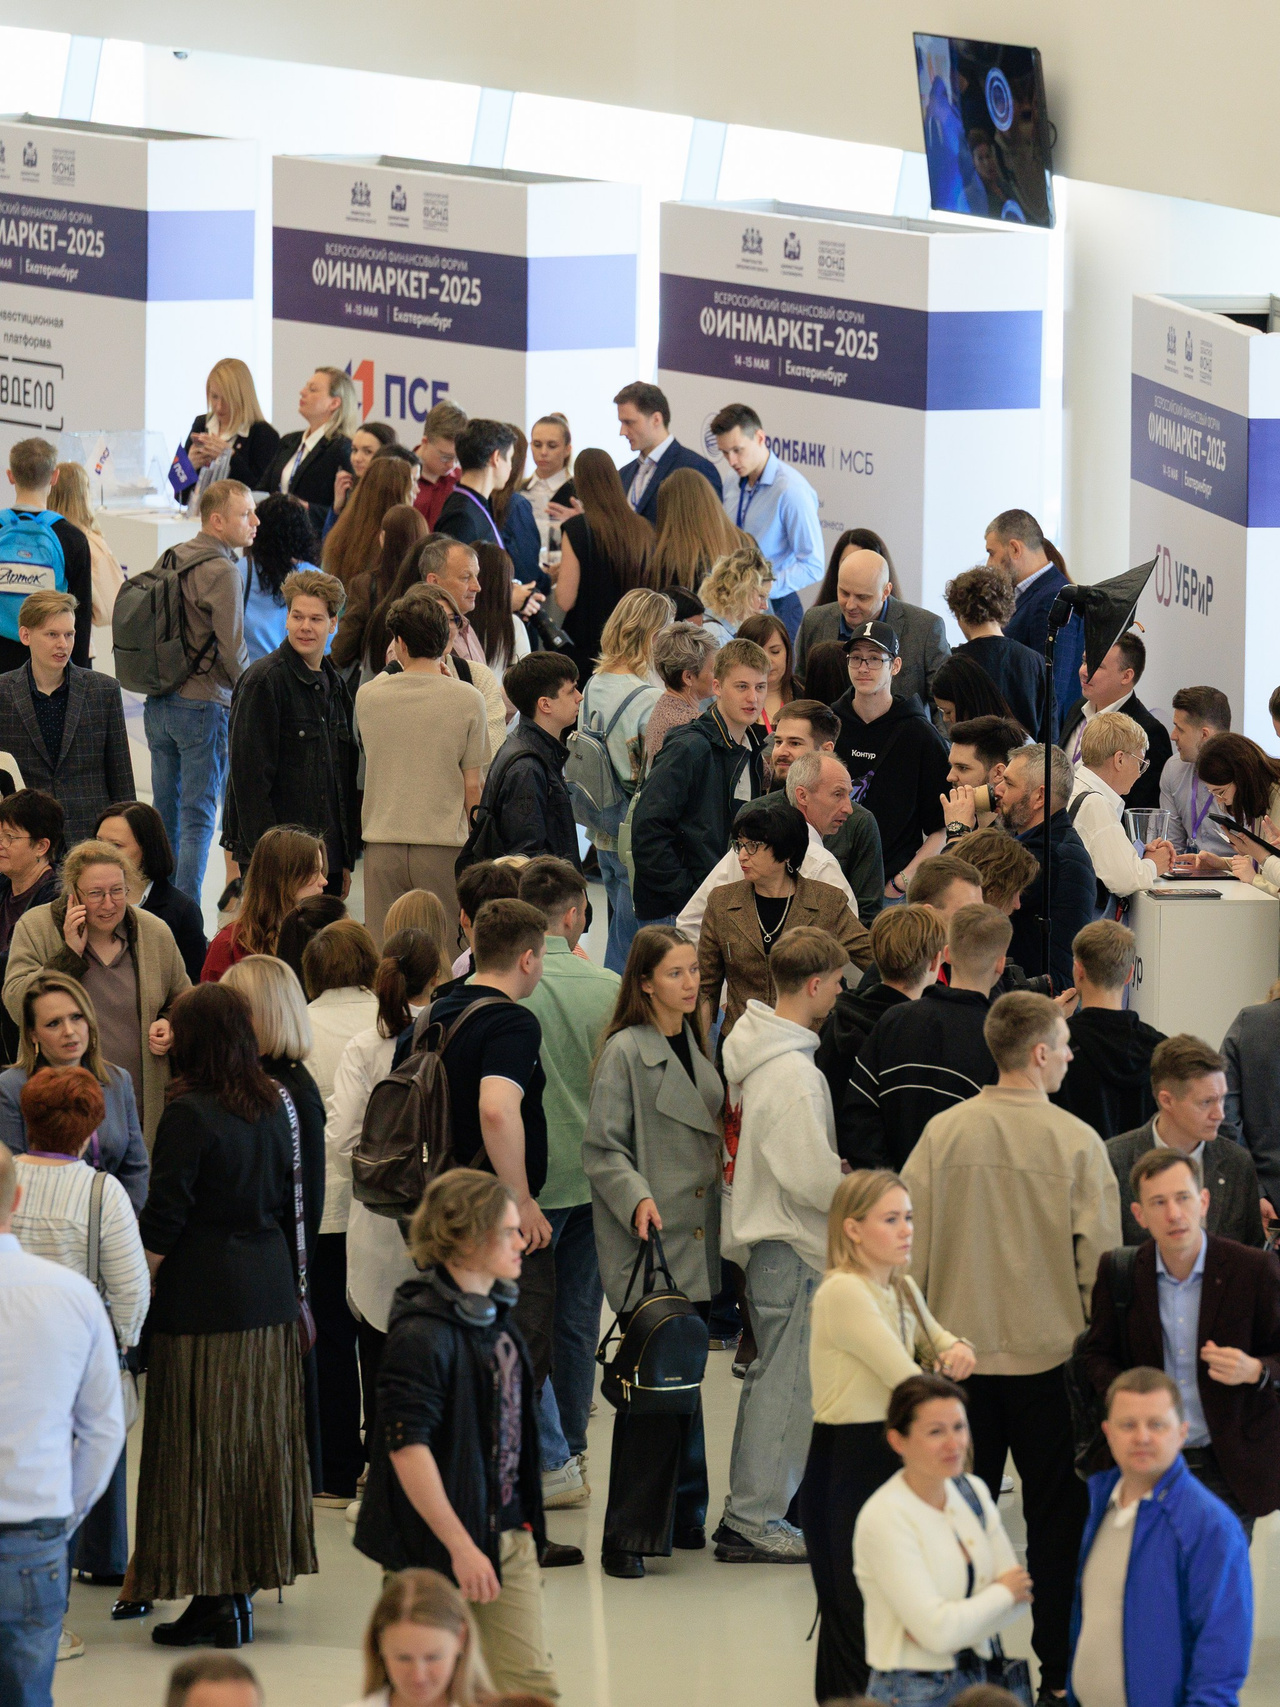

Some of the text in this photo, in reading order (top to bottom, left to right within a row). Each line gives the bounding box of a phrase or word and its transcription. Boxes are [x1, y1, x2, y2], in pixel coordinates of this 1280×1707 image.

[25, 258, 79, 283] Екатеринбург
[325, 242, 469, 271] ВСЕРОССИЙСКИЙ ФИНАНСОВЫЙ ФОРУМ
[393, 307, 453, 332] Екатеринбург
[714, 291, 866, 325] ВСЕРОССИЙСКИЙ ФИНАНСОВЫЙ ФОРУМ
[3, 332, 52, 350] платформа
[785, 360, 849, 388] Екатеринбург
[840, 448, 874, 476] МСБ
[1184, 469, 1213, 500] Екатеринбург
[1175, 562, 1213, 616] УБРиР
[851, 749, 877, 760] Контур
